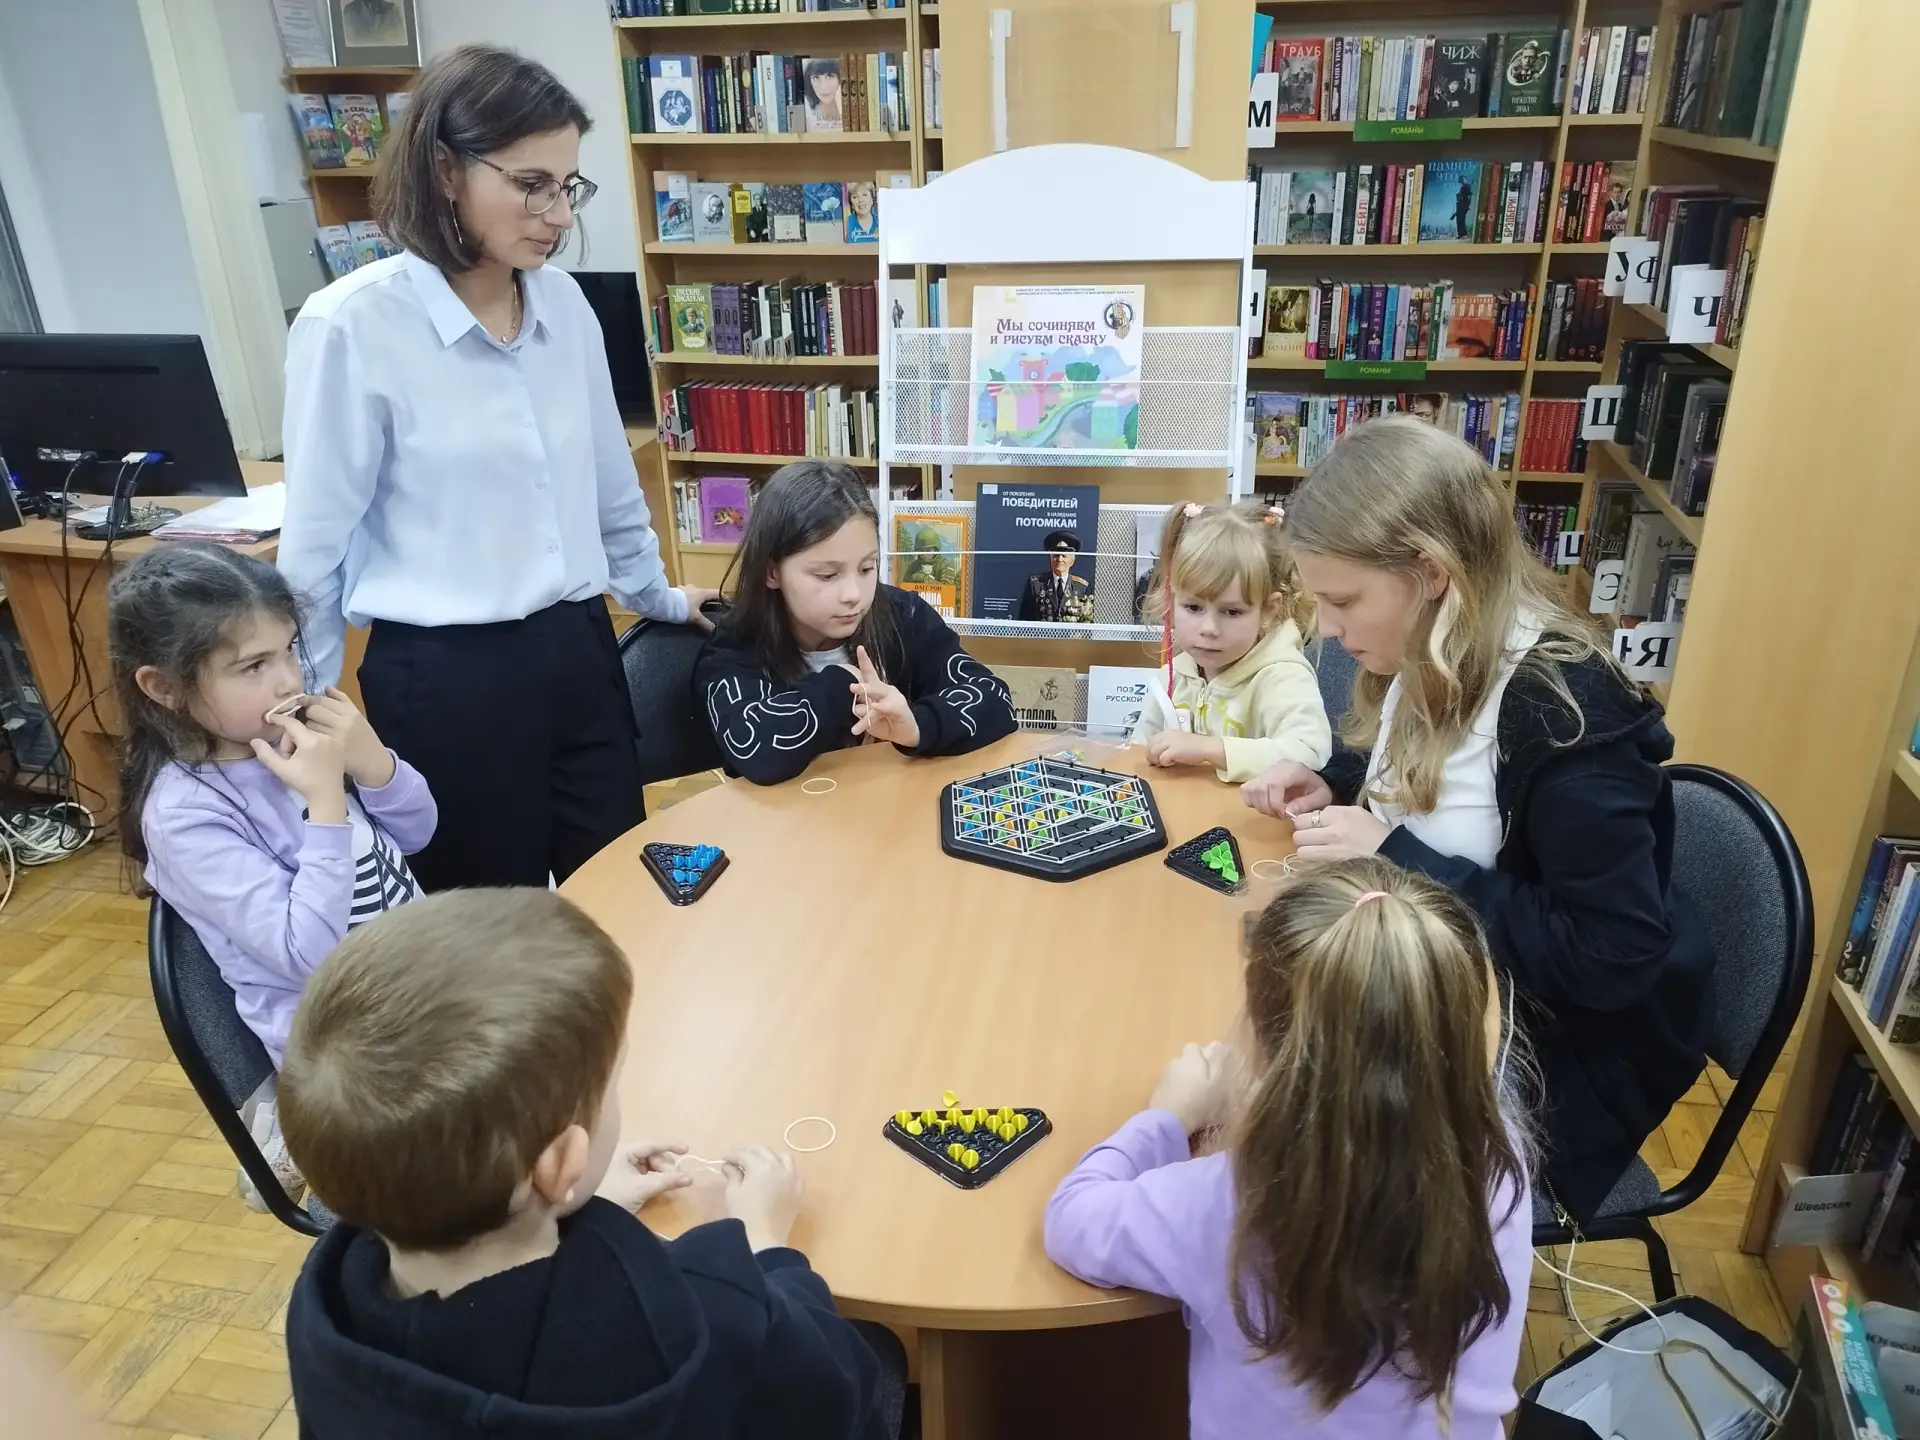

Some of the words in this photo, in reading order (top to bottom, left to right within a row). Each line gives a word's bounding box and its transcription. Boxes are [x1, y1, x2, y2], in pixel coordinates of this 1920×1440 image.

[1280, 43, 1321, 57] ТРАУБ
[1442, 45, 1481, 60] ЧИЖ
[1248, 100, 1272, 128] М
[1391, 126, 1424, 135] РОМАНЫ
[1636, 256, 1659, 283] Ф
[1692, 296, 1723, 328] Ч
[997, 318, 1023, 334] Мы
[1002, 497, 1078, 509] ПОБЕДИТЕЛЕЙ
[1015, 518, 1078, 529] ПОТОМКАМ
[1598, 573, 1622, 601] Э
[1632, 637, 1675, 668] Я
[1106, 694, 1143, 703] РУССКОЙ
